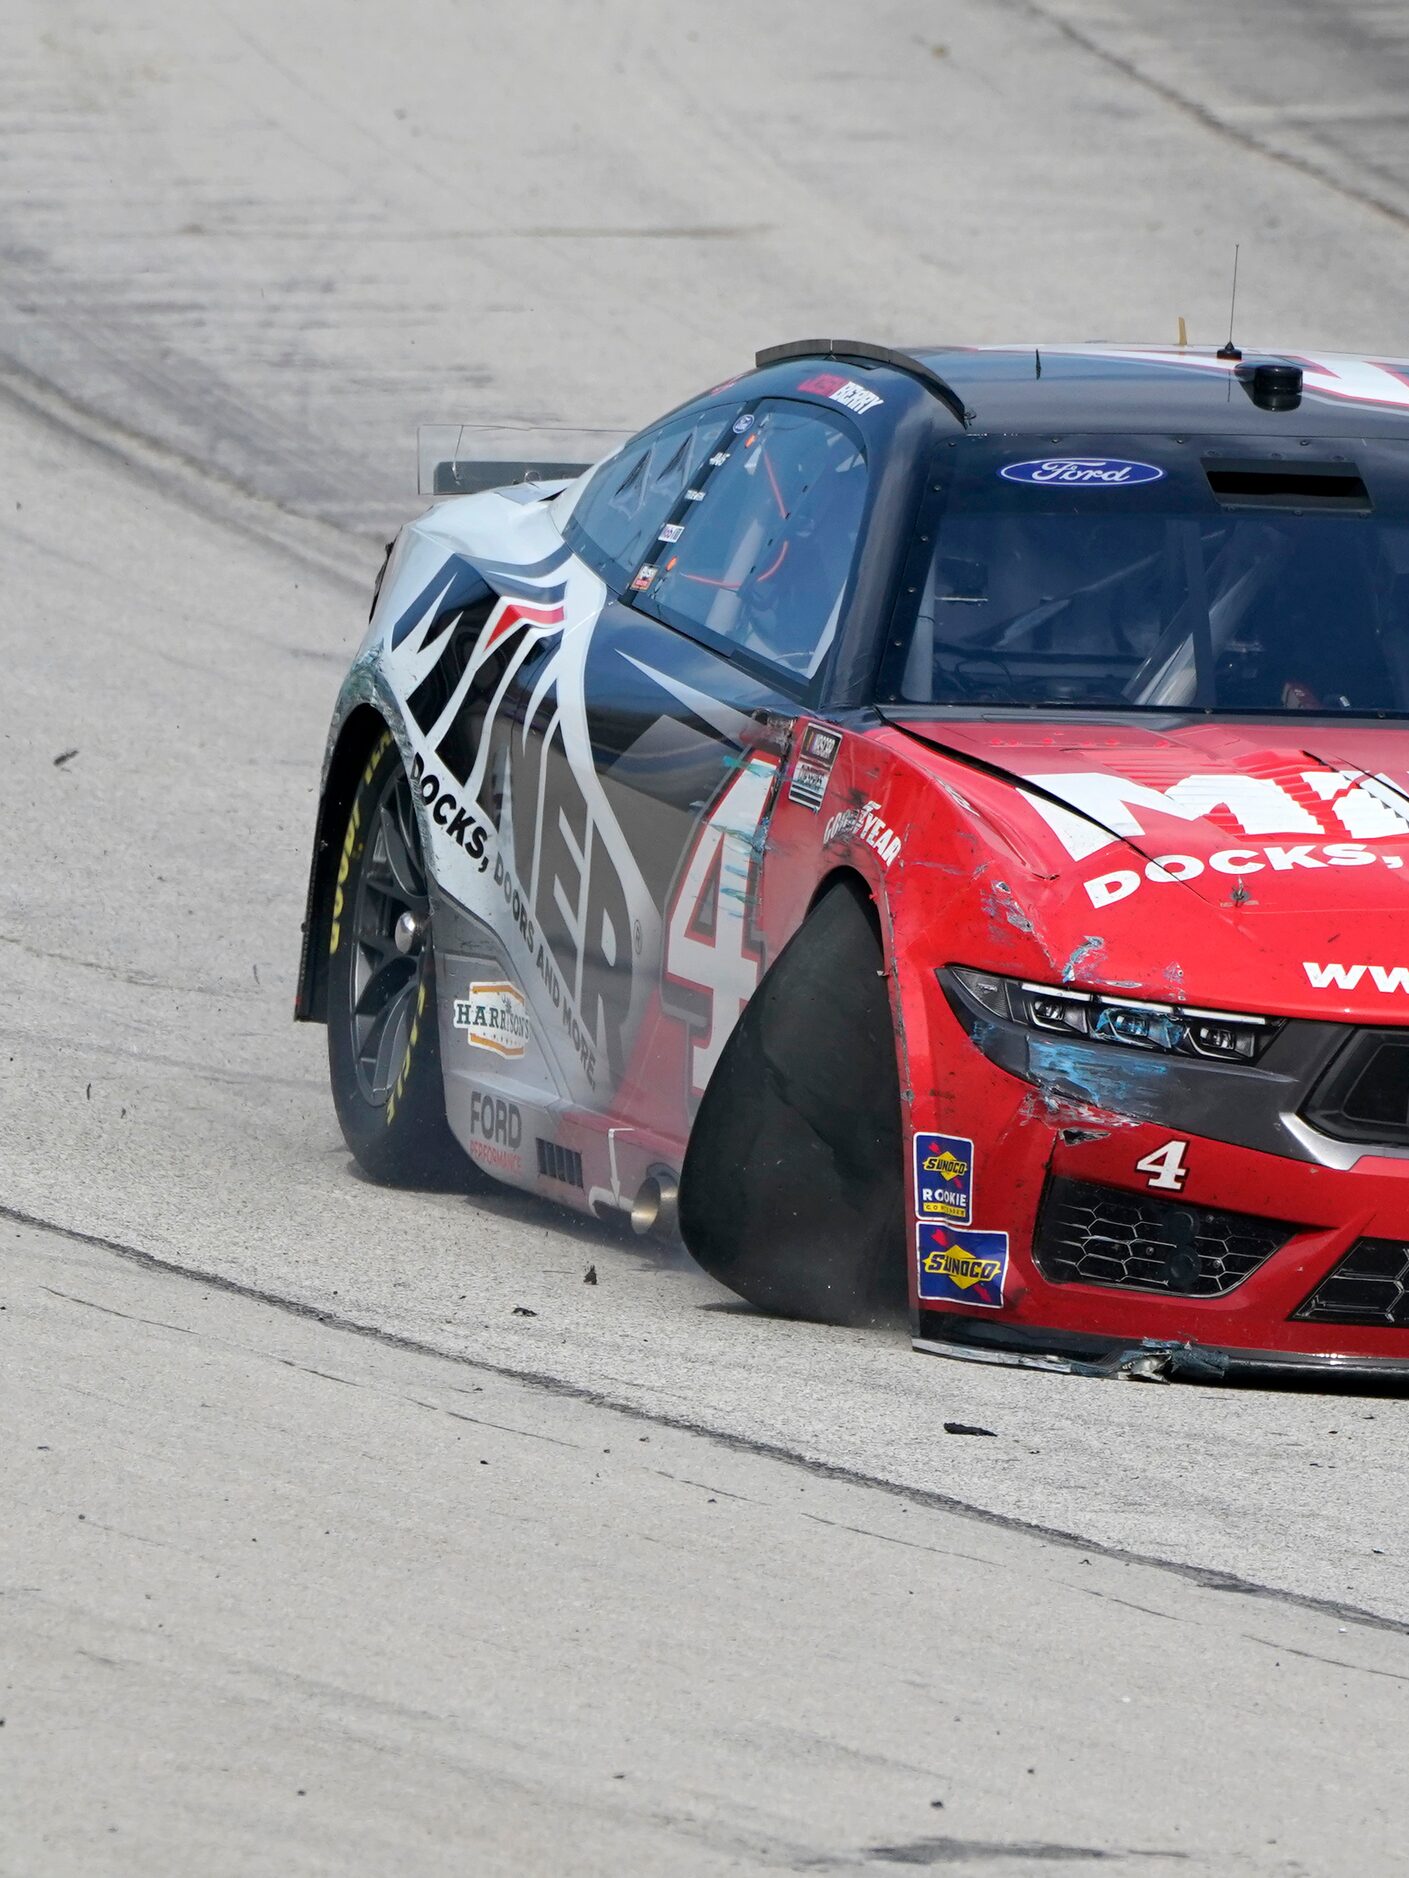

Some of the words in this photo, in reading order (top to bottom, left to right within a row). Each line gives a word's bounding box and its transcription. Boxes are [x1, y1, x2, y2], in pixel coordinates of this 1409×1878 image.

[1032, 461, 1131, 481] Ford
[1083, 843, 1404, 909] DOCKS,
[494, 851, 535, 953] DOORS
[536, 943, 560, 1008] AND
[470, 1090, 522, 1149] FORD
[926, 1158, 966, 1175] SUNOCO
[1136, 1140, 1189, 1190] 4
[922, 1188, 967, 1207] ROOKIE
[928, 1253, 997, 1282] SUNOCO
